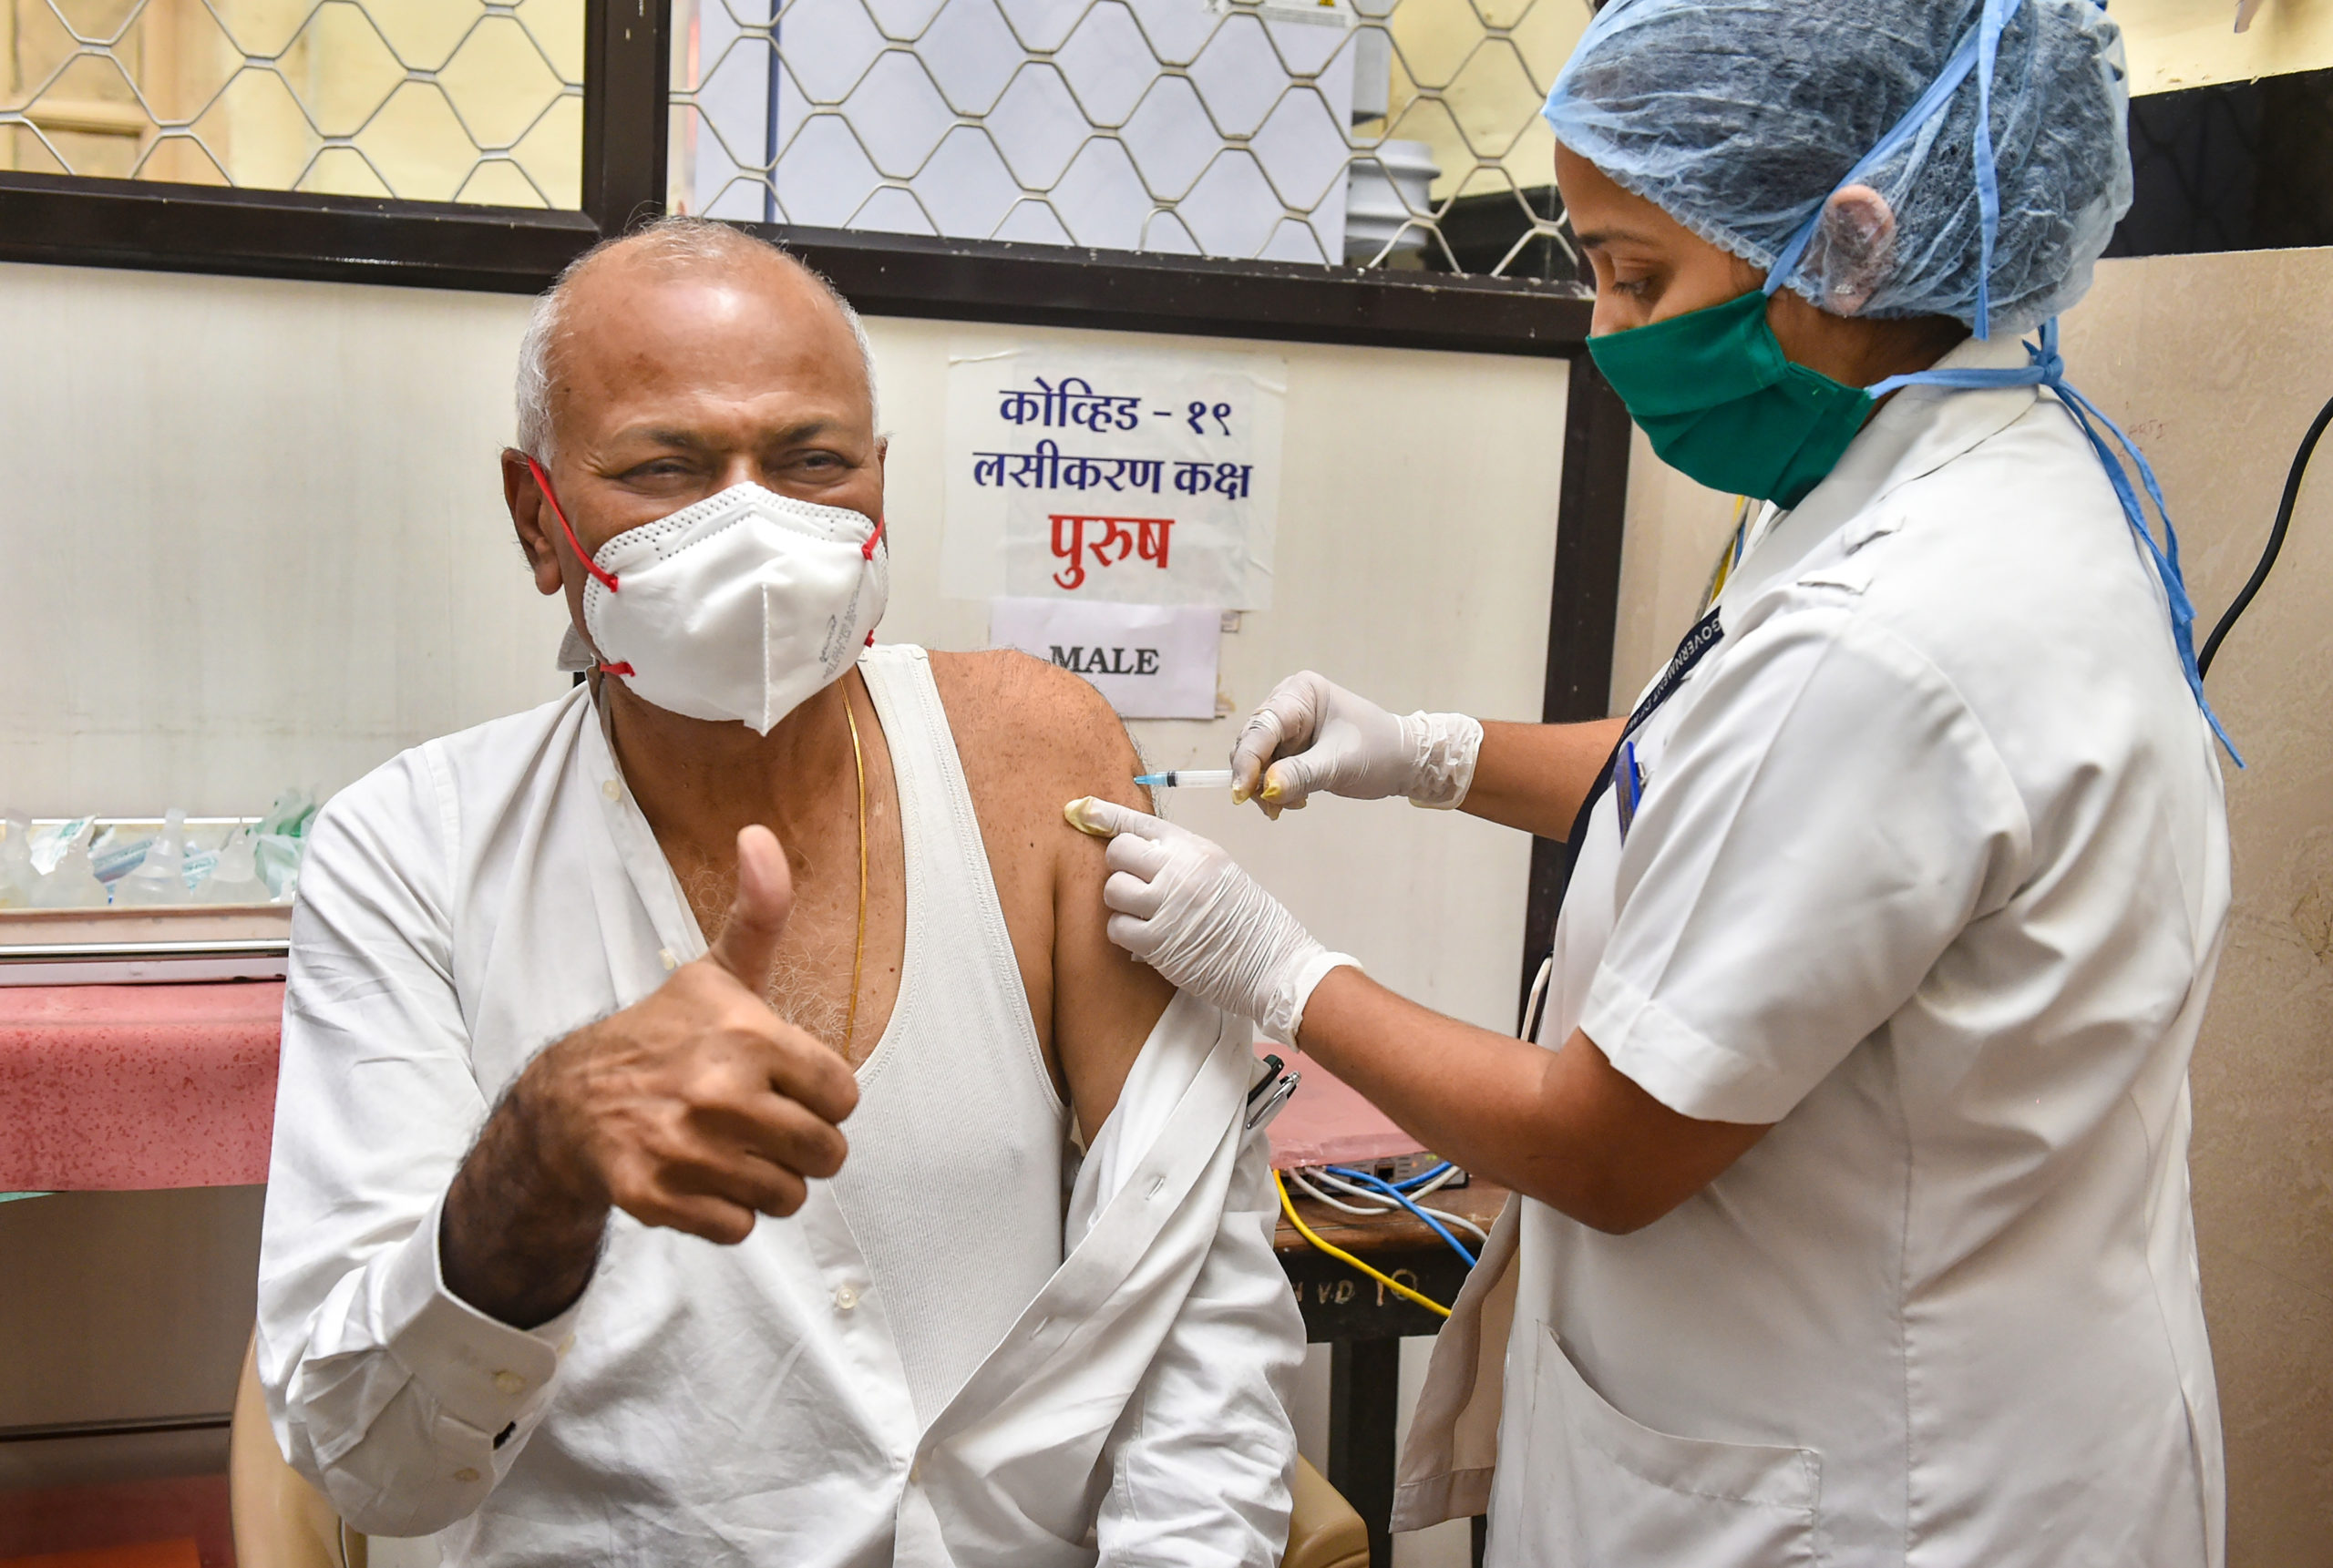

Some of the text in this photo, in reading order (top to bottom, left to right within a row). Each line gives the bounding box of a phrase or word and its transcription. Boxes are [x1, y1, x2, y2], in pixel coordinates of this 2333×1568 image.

[999, 376, 1141, 433] कोव्हिड
[1187, 401, 1231, 436] १९
[972, 438, 1254, 501] लसीकरण कक्ष
[1047, 513, 1177, 590] पुरुष
[1049, 645, 1160, 676] MALE
[1652, 618, 1721, 703] GOVERNMENT
